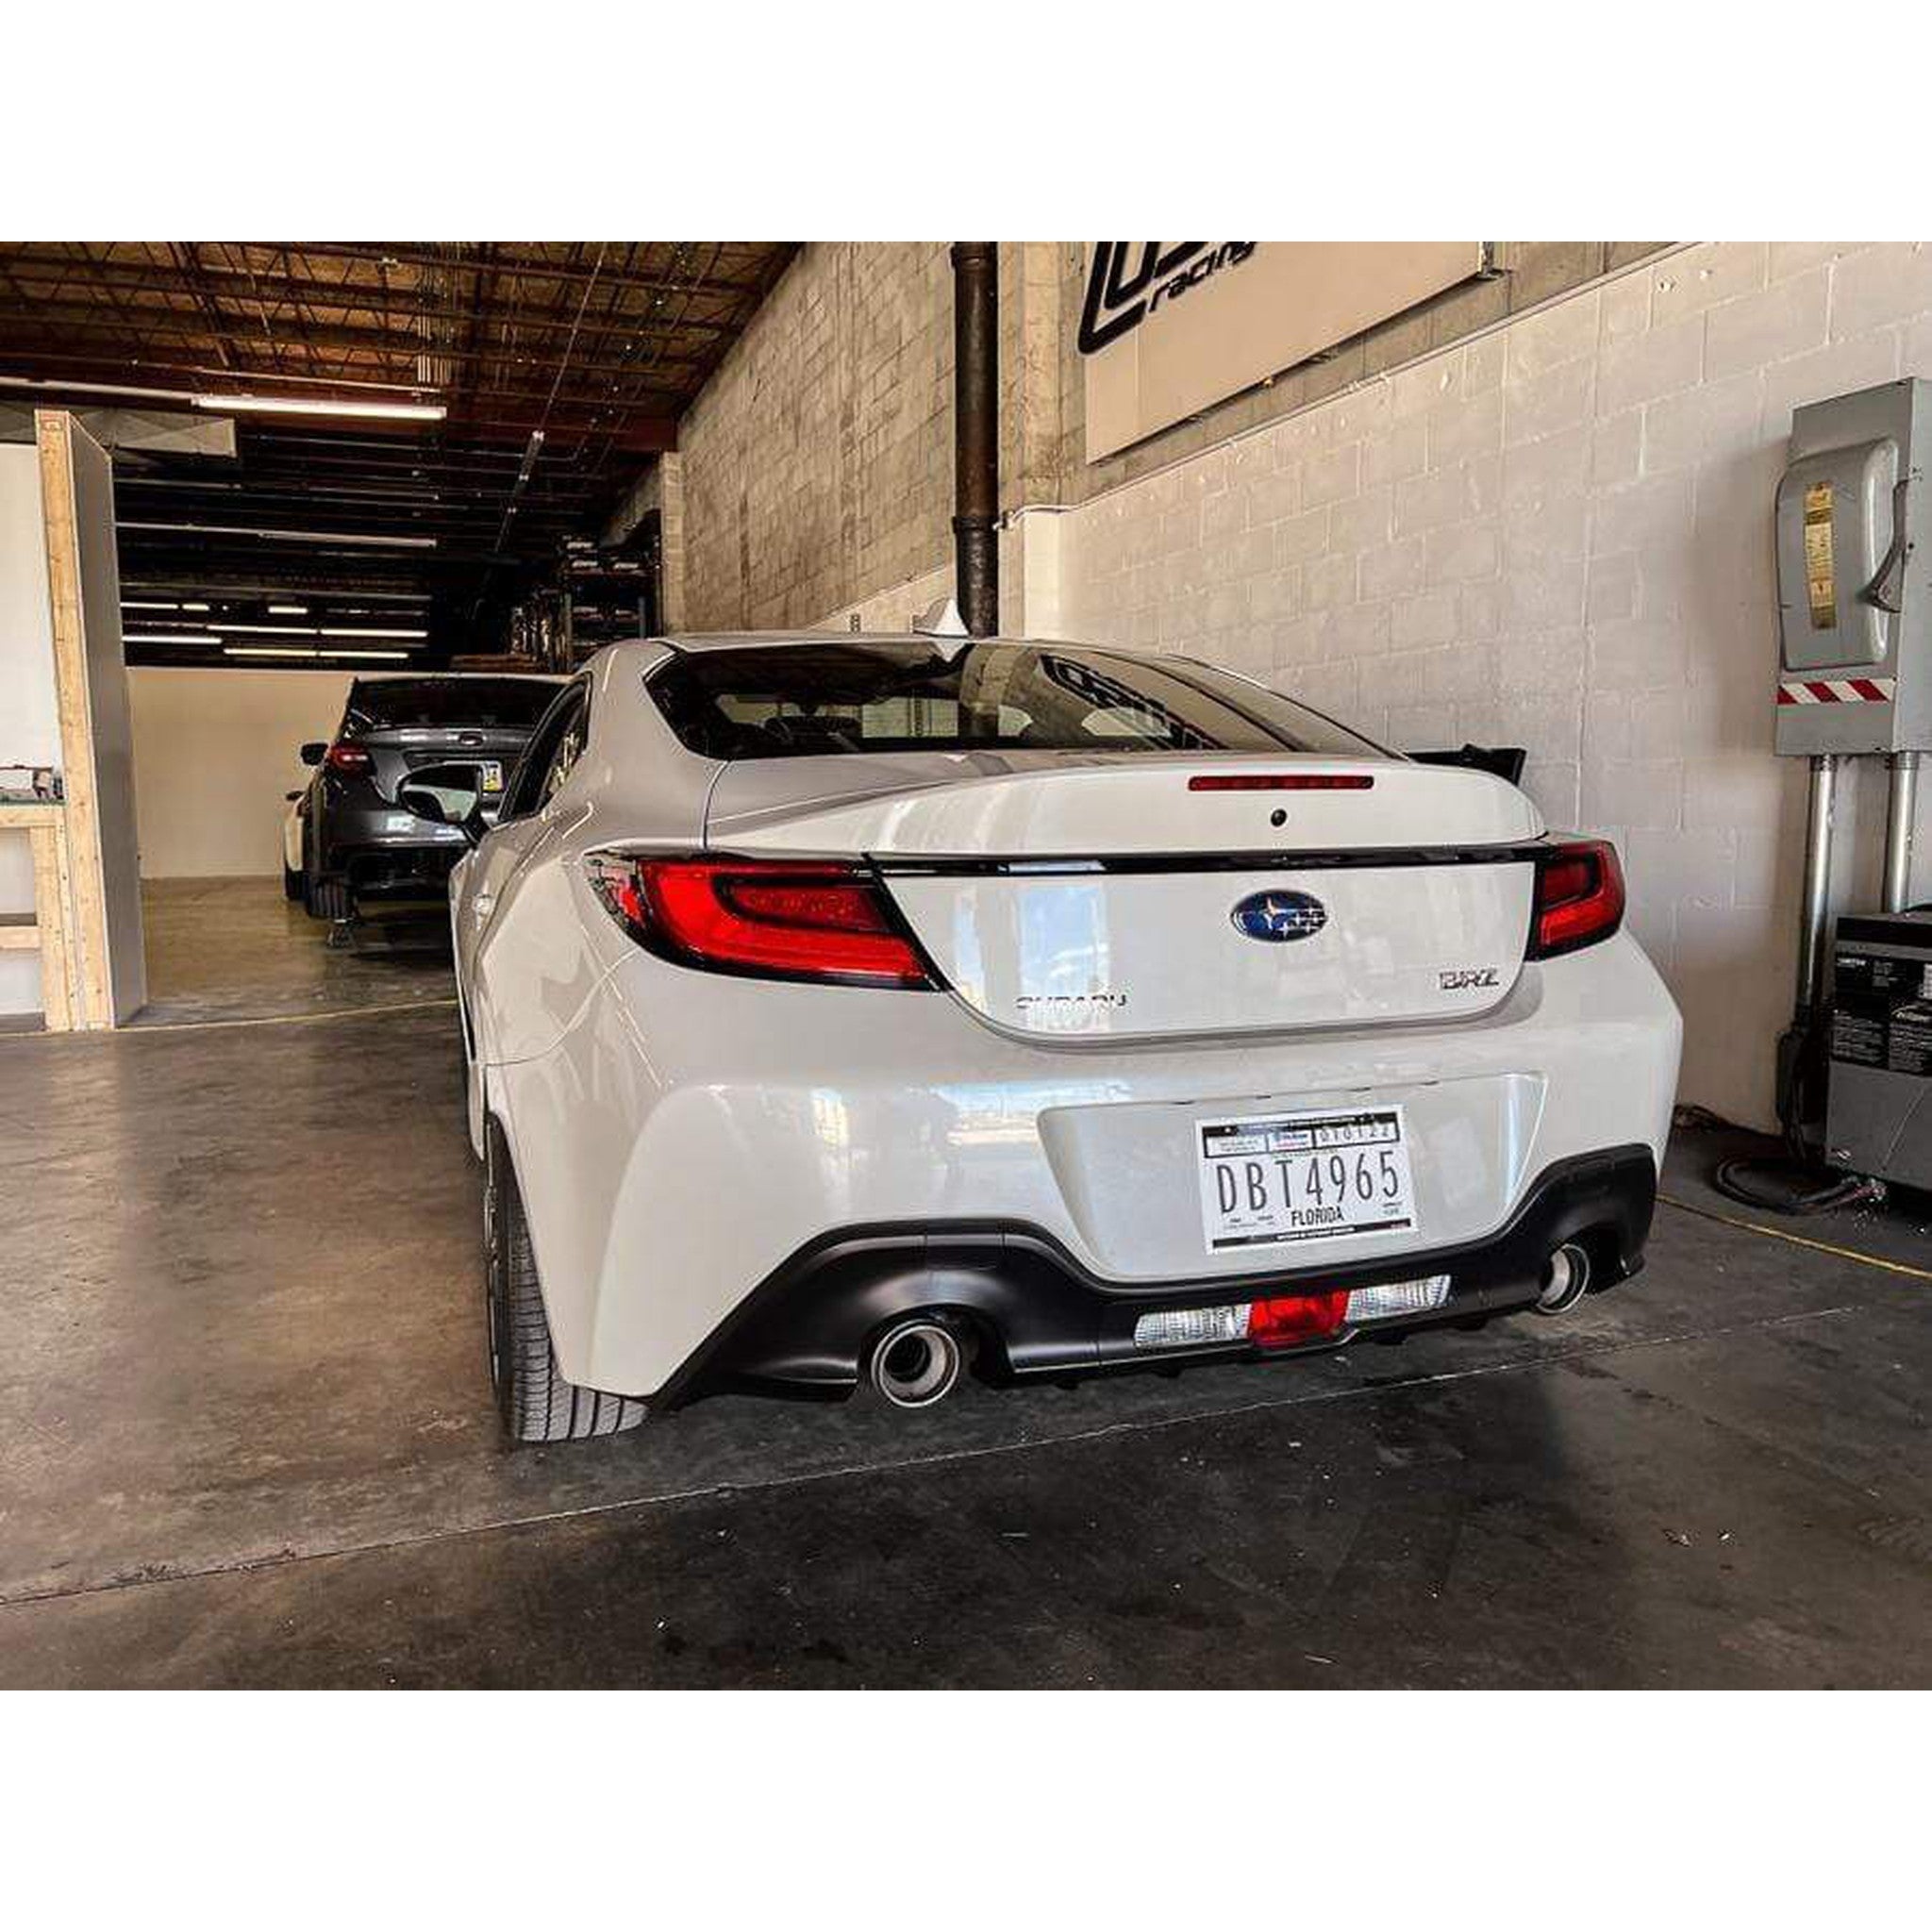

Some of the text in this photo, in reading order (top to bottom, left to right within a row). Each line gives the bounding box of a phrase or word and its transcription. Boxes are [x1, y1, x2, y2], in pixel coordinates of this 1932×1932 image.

[1440, 968, 1499, 990] BRZ
[1216, 1150, 1399, 1213] DBT4965
[1291, 1205, 1345, 1226] FLORIDA
